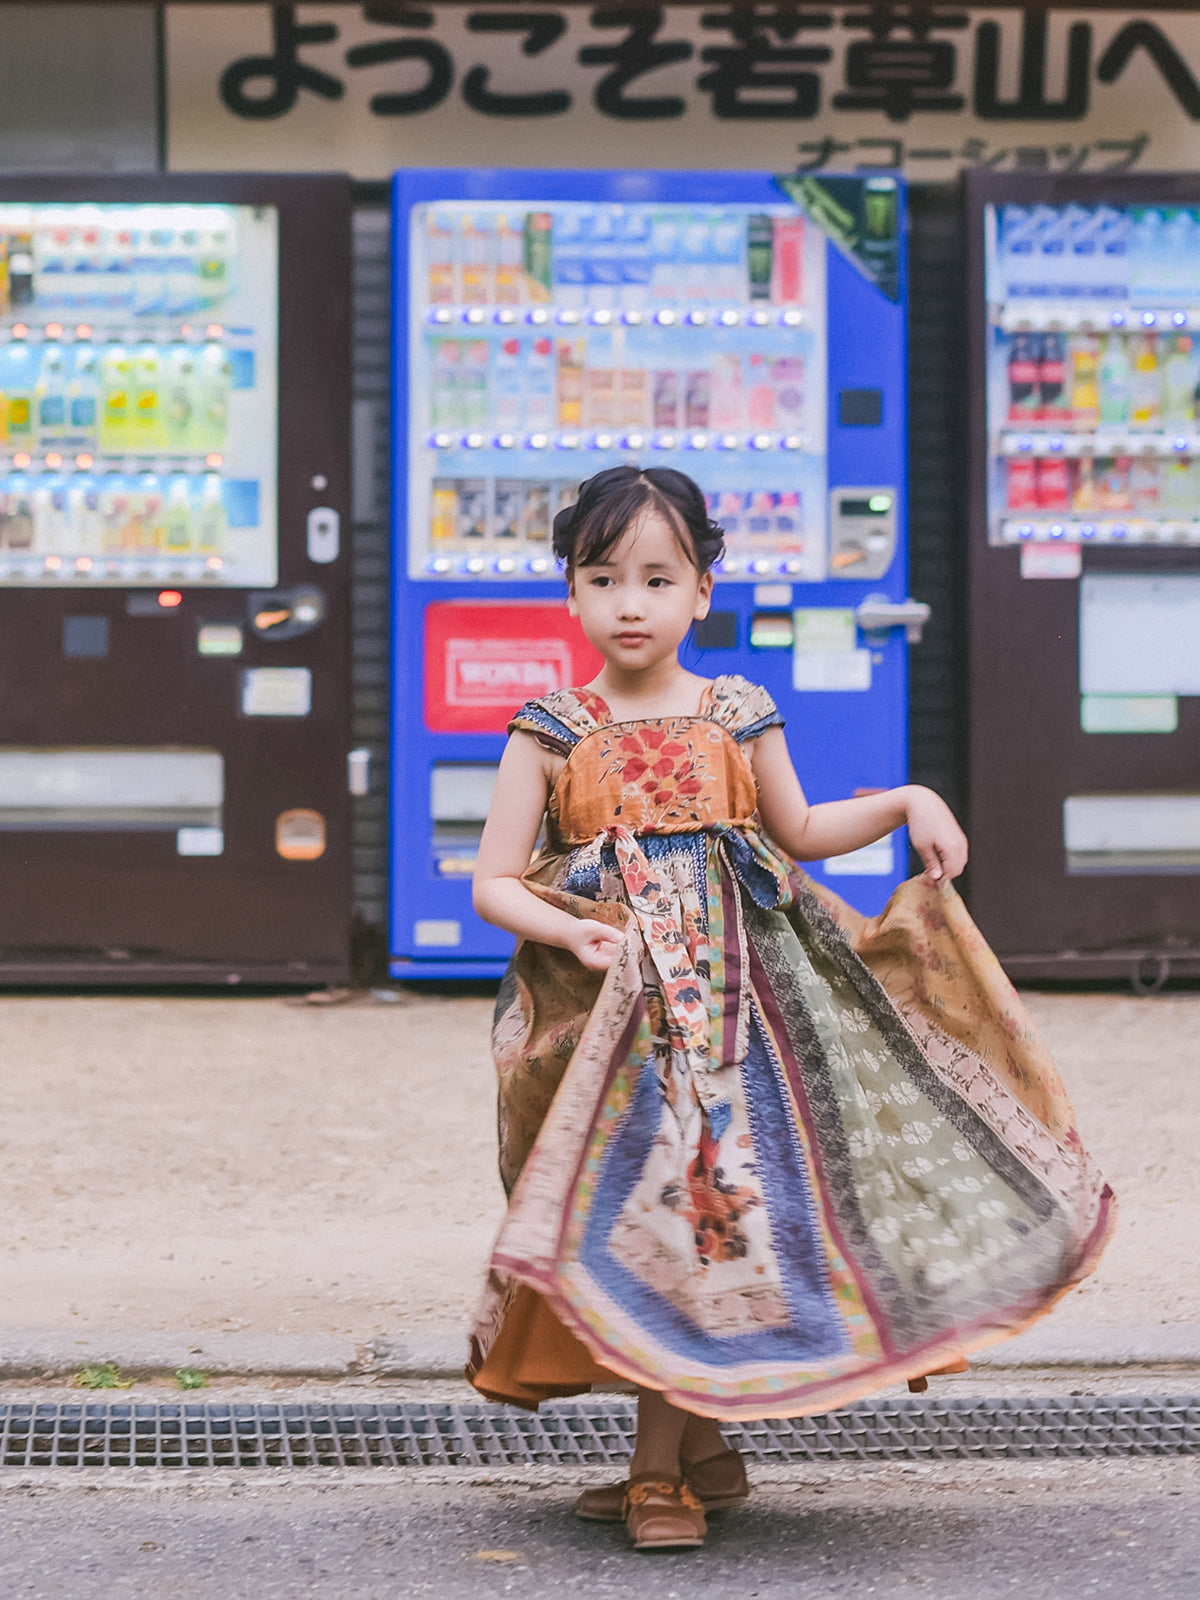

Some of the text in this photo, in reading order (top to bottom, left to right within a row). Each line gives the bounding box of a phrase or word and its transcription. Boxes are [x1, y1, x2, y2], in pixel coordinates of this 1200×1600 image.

[219, 3, 1200, 121] ようこそ若草山へ
